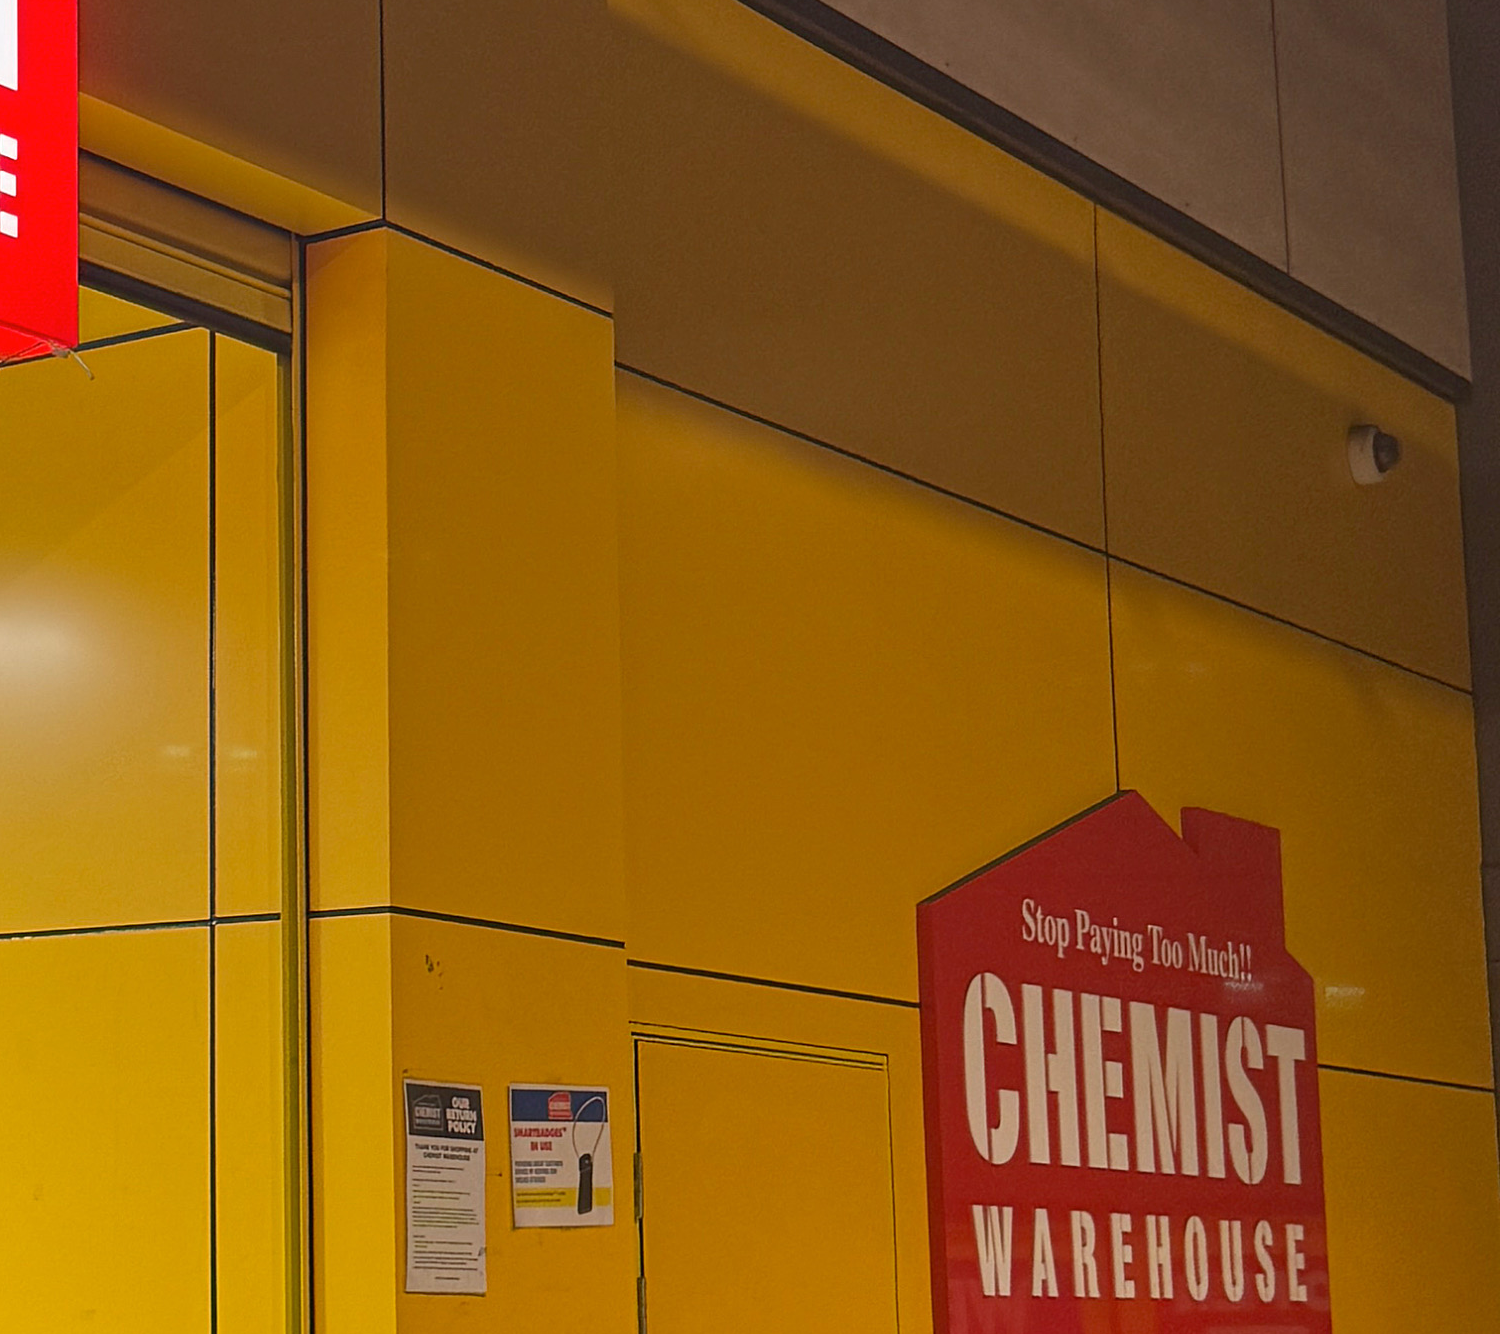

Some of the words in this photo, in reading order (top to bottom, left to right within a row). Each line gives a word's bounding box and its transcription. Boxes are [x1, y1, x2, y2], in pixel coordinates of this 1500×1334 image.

[1021, 897, 1070, 959] Stop
[1075, 908, 1145, 973] Paying
[1147, 924, 1183, 970] Too
[1187, 935, 1252, 982] Much!!
[452, 1096, 470, 1109] OUR
[963, 972, 1306, 1186] CHEMIST
[448, 1120, 476, 1134] POLICY
[972, 1204, 1309, 1303] WAREHOUSE
